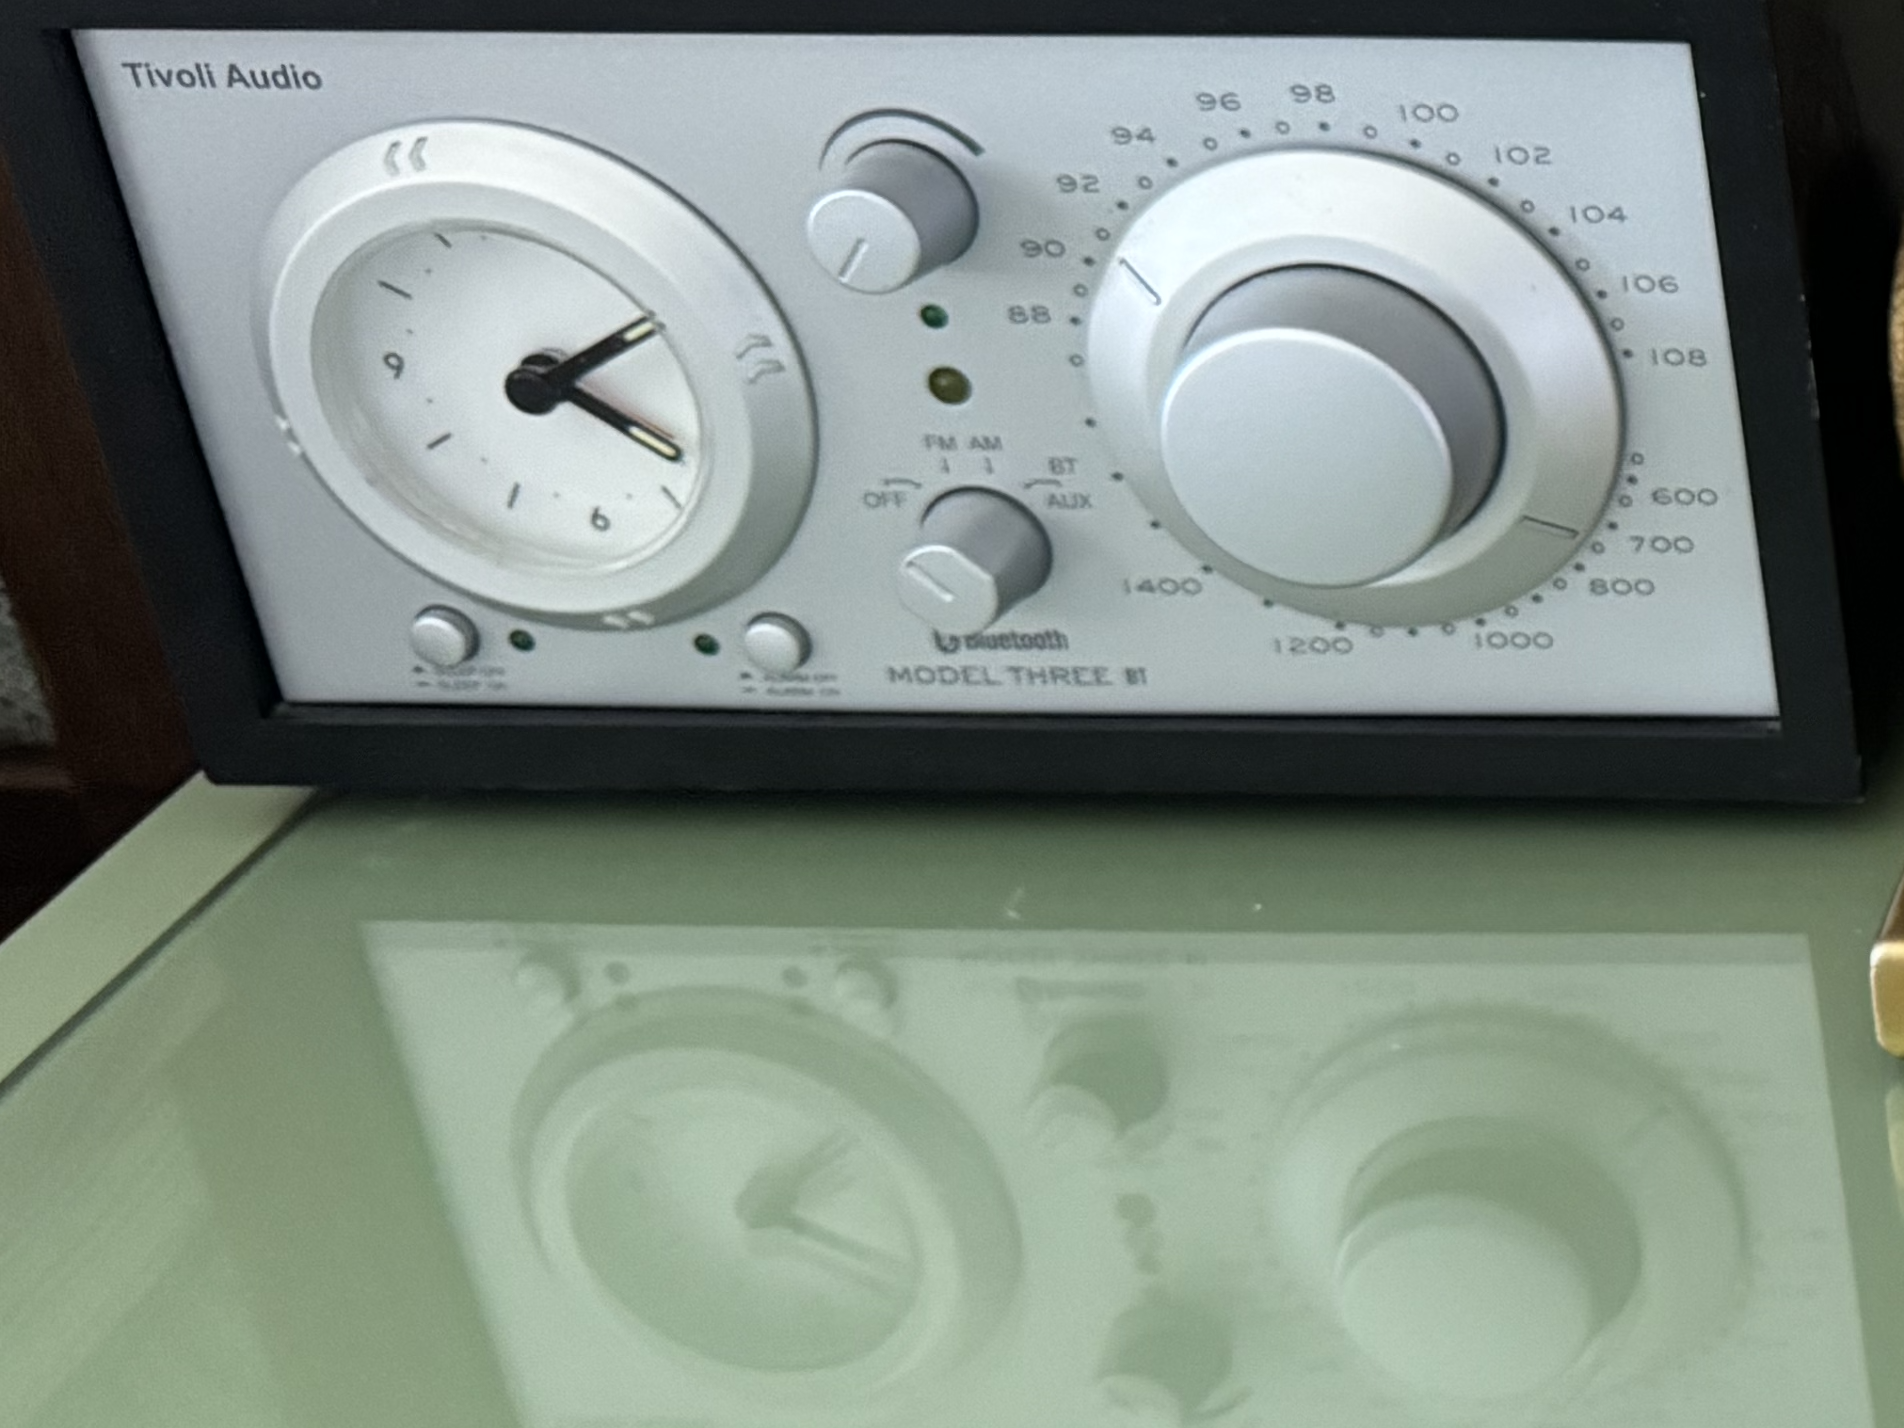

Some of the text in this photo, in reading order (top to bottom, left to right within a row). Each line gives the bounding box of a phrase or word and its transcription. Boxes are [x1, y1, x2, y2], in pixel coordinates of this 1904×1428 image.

[122, 62, 323, 91] Tivoli Audio
[1196, 92, 1241, 111] 96
[1290, 84, 1336, 104] 98
[1398, 103, 1459, 124] 100
[1110, 126, 1156, 144] 94
[1494, 146, 1552, 165] 102
[1056, 175, 1100, 193] 92
[1569, 204, 1627, 224] 104
[1020, 240, 1065, 257] 90
[1621, 275, 1679, 295] 106
[1008, 306, 1052, 325] 88
[383, 352, 404, 378] 9
[1650, 347, 1706, 368] 108
[923, 434, 1002, 451] FM AM
[863, 490, 907, 508] OFF
[1047, 492, 1093, 509] AUX
[1652, 487, 1718, 507] 600
[590, 507, 610, 531] 6
[1630, 535, 1694, 555] 700
[1123, 578, 1203, 596] 1400
[1590, 578, 1655, 598] 800
[1273, 636, 1353, 656] 1200
[1474, 632, 1553, 652] 1000
[887, 665, 1002, 686] MODEL
[1007, 665, 1113, 686] THREE
